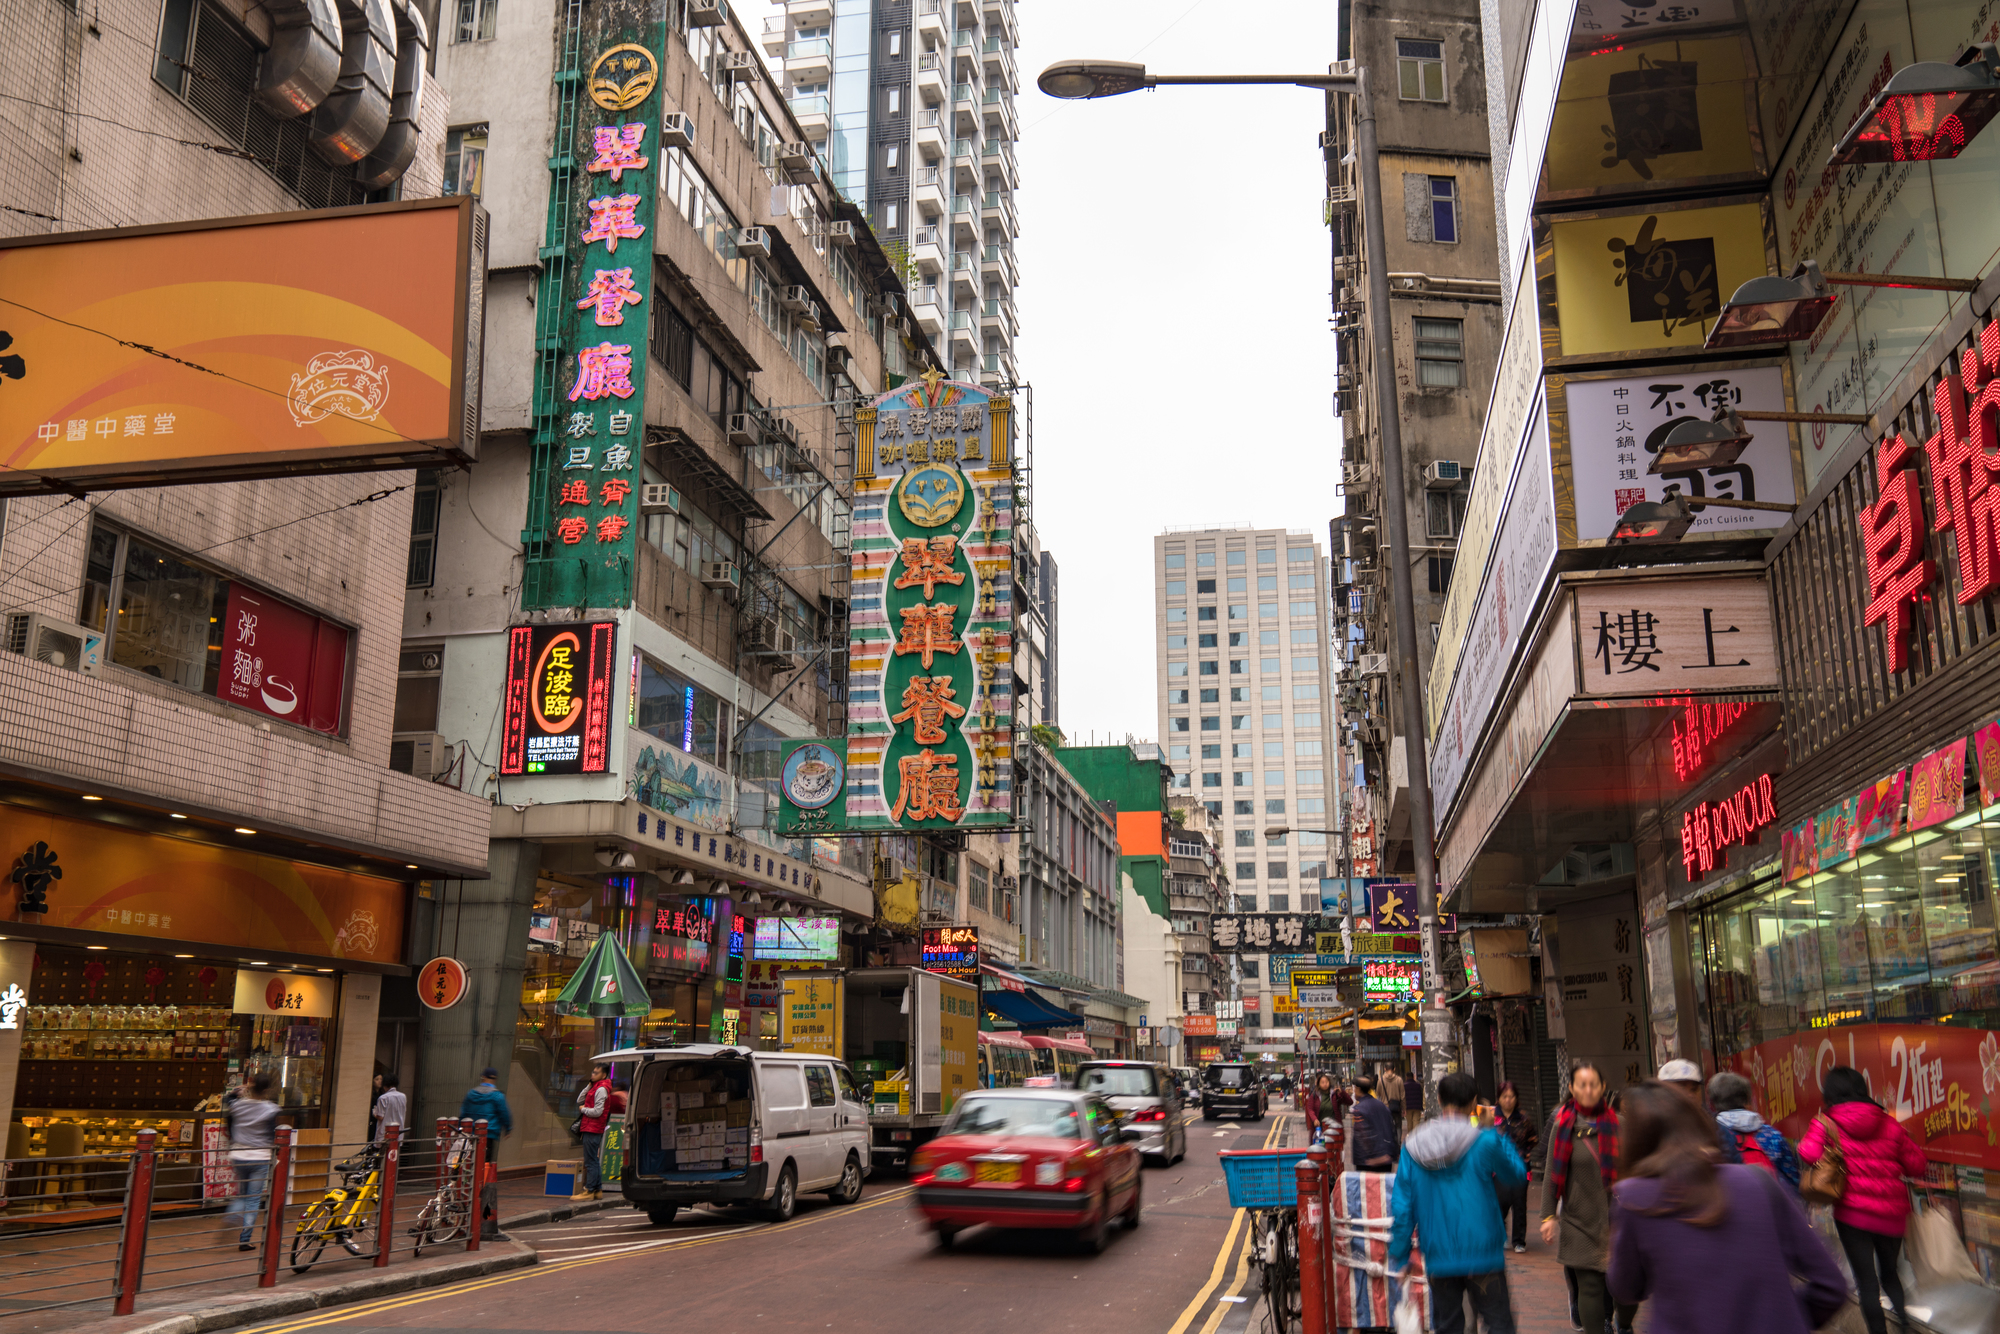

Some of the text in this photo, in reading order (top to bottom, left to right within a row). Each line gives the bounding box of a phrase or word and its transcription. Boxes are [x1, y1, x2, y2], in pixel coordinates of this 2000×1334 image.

[568, 122, 649, 402] 翠華餐廳
[308, 373, 370, 396] 位元堂
[37, 412, 176, 444] 中醫中藥堂
[1613, 386, 1639, 482] 中日火鍋料理
[979, 484, 997, 548] TSUI
[1717, 514, 1754, 523] Cuisine
[978, 564, 996, 613] WAH
[1592, 607, 1751, 675] 樓上
[890, 534, 967, 822] 翠華餐廳
[978, 627, 996, 806] RESTAURANT
[1714, 772, 1777, 850] BONJOUR
[1680, 801, 1713, 882] 卓悅
[106, 908, 172, 930] 中醫中藥堂
[655, 909, 686, 936] 翠華
[1212, 918, 1304, 947] 老地坊
[652, 943, 669, 959] TSUI
[672, 945, 687, 960] WAH
[923, 944, 941, 953] Foot
[1318, 955, 1346, 966] Trave
[433, 962, 447, 1004] 位元堂
[274, 993, 304, 1010] 位元堂
[792, 1012, 816, 1020] 有限公司
[792, 1025, 825, 1034] 訂貨熱線
[813, 1035, 832, 1043] 1211
